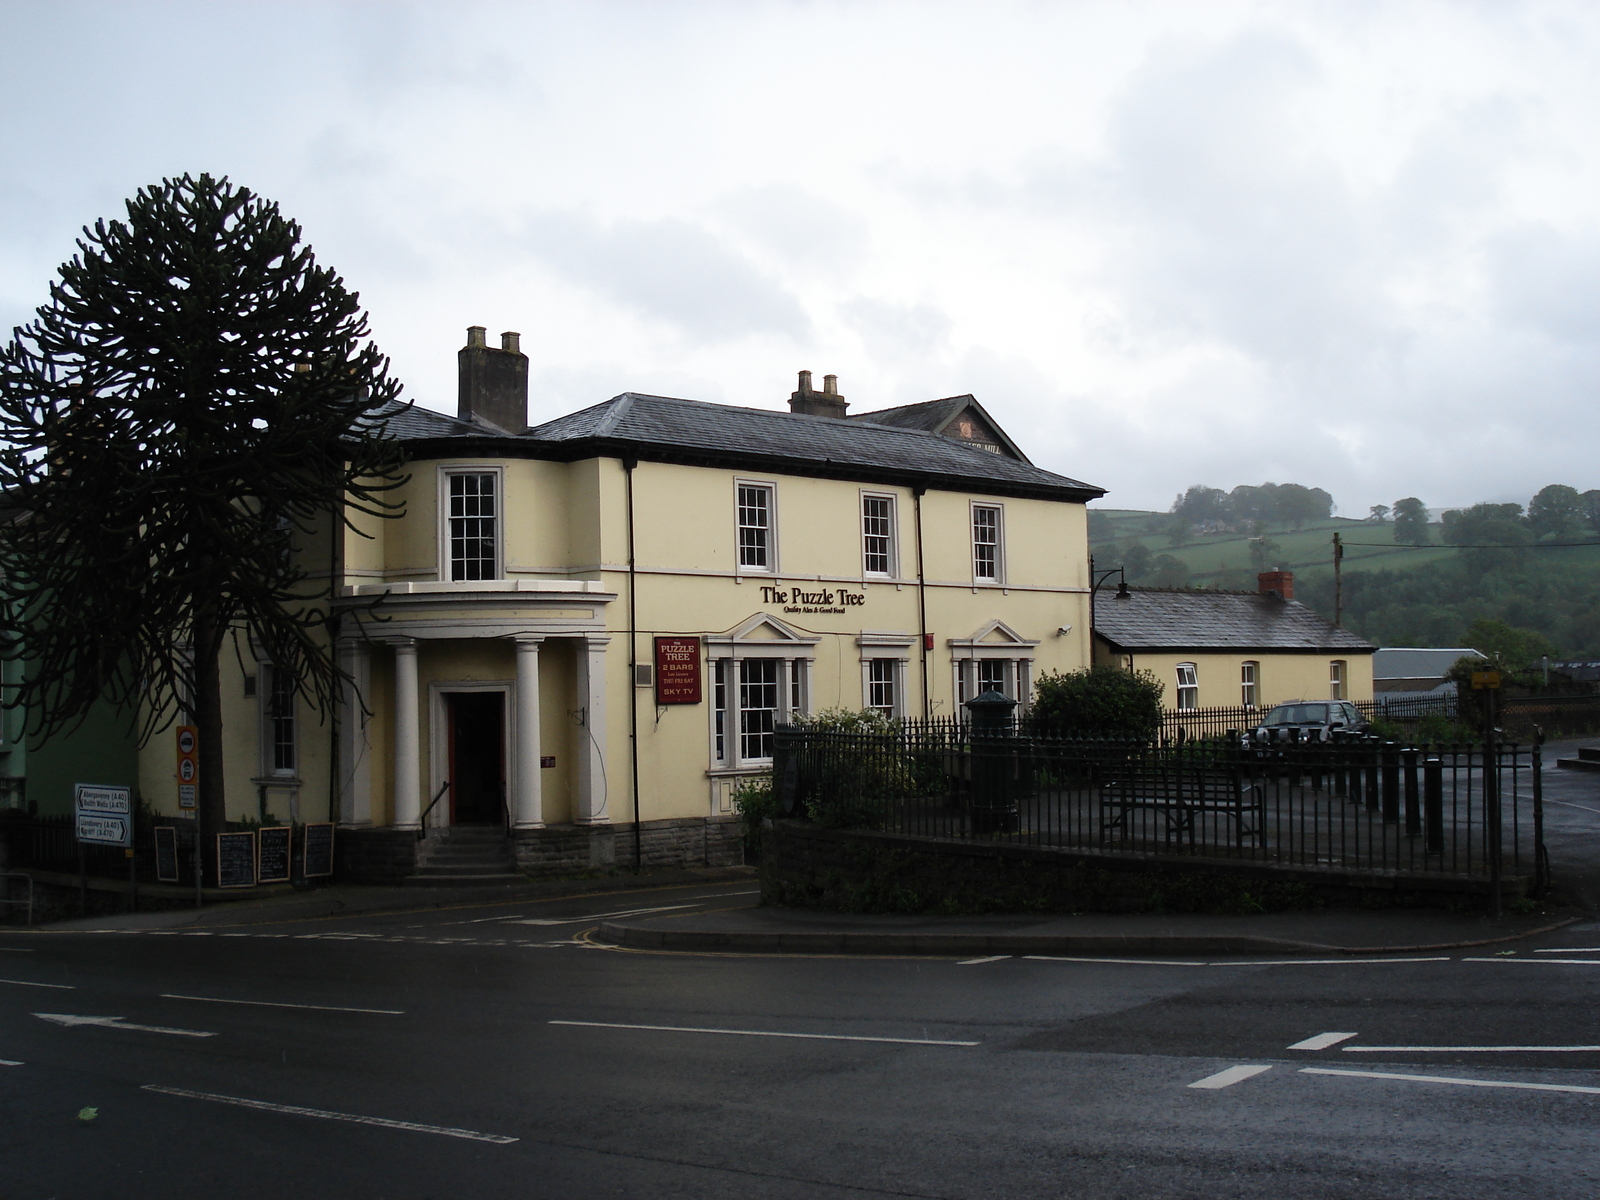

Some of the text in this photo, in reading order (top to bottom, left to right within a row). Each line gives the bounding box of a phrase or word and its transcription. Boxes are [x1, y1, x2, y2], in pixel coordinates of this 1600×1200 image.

[760, 586, 866, 606] The Puzzle Tree
[783, 605, 801, 614] Quality
[661, 645, 695, 653] PUZZLE
[665, 653, 690, 661] TREE
